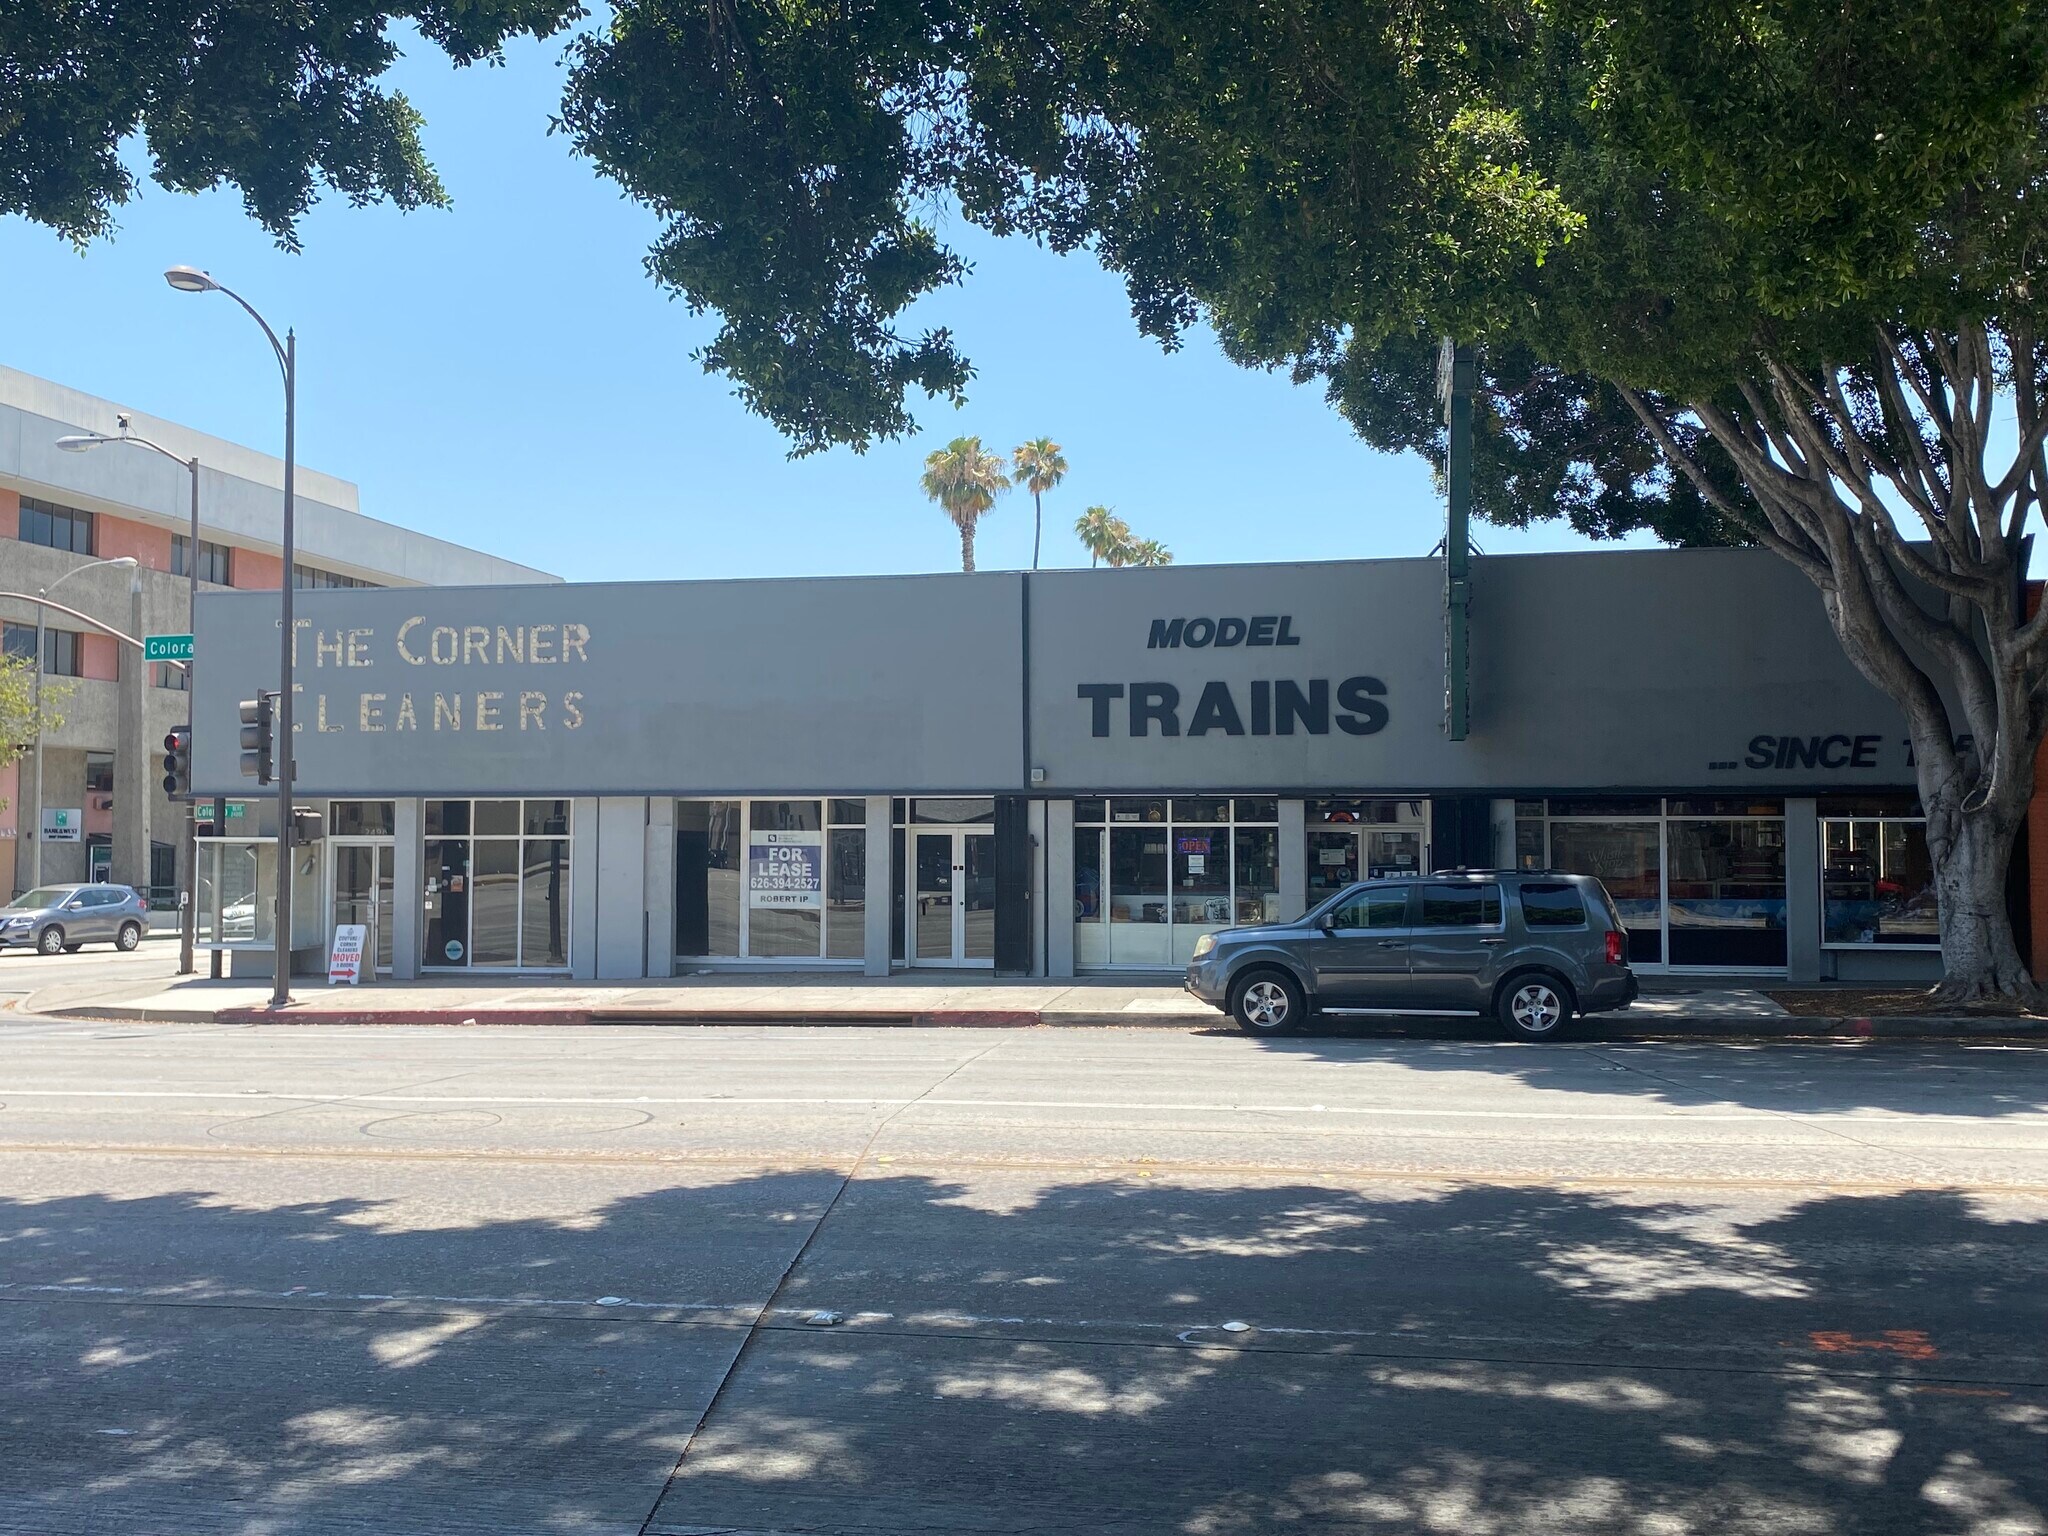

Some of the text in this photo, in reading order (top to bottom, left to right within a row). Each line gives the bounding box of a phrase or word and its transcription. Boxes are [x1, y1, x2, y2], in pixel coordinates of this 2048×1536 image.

[1147, 616, 1300, 649] MODEL
[150, 641, 194, 655] Colora
[275, 616, 591, 668] THE CORNER
[275, 683, 584, 733] CLEANERS
[1077, 676, 1389, 737] TRAINS
[197, 806, 228, 817] Coloo
[1182, 841, 1208, 851] OPEN
[769, 847, 803, 862] FOR
[759, 863, 812, 877] LEASE
[751, 877, 819, 889] 626-394-2527
[760, 895, 809, 903] ROBERT IP
[332, 953, 360, 962] MOVED
